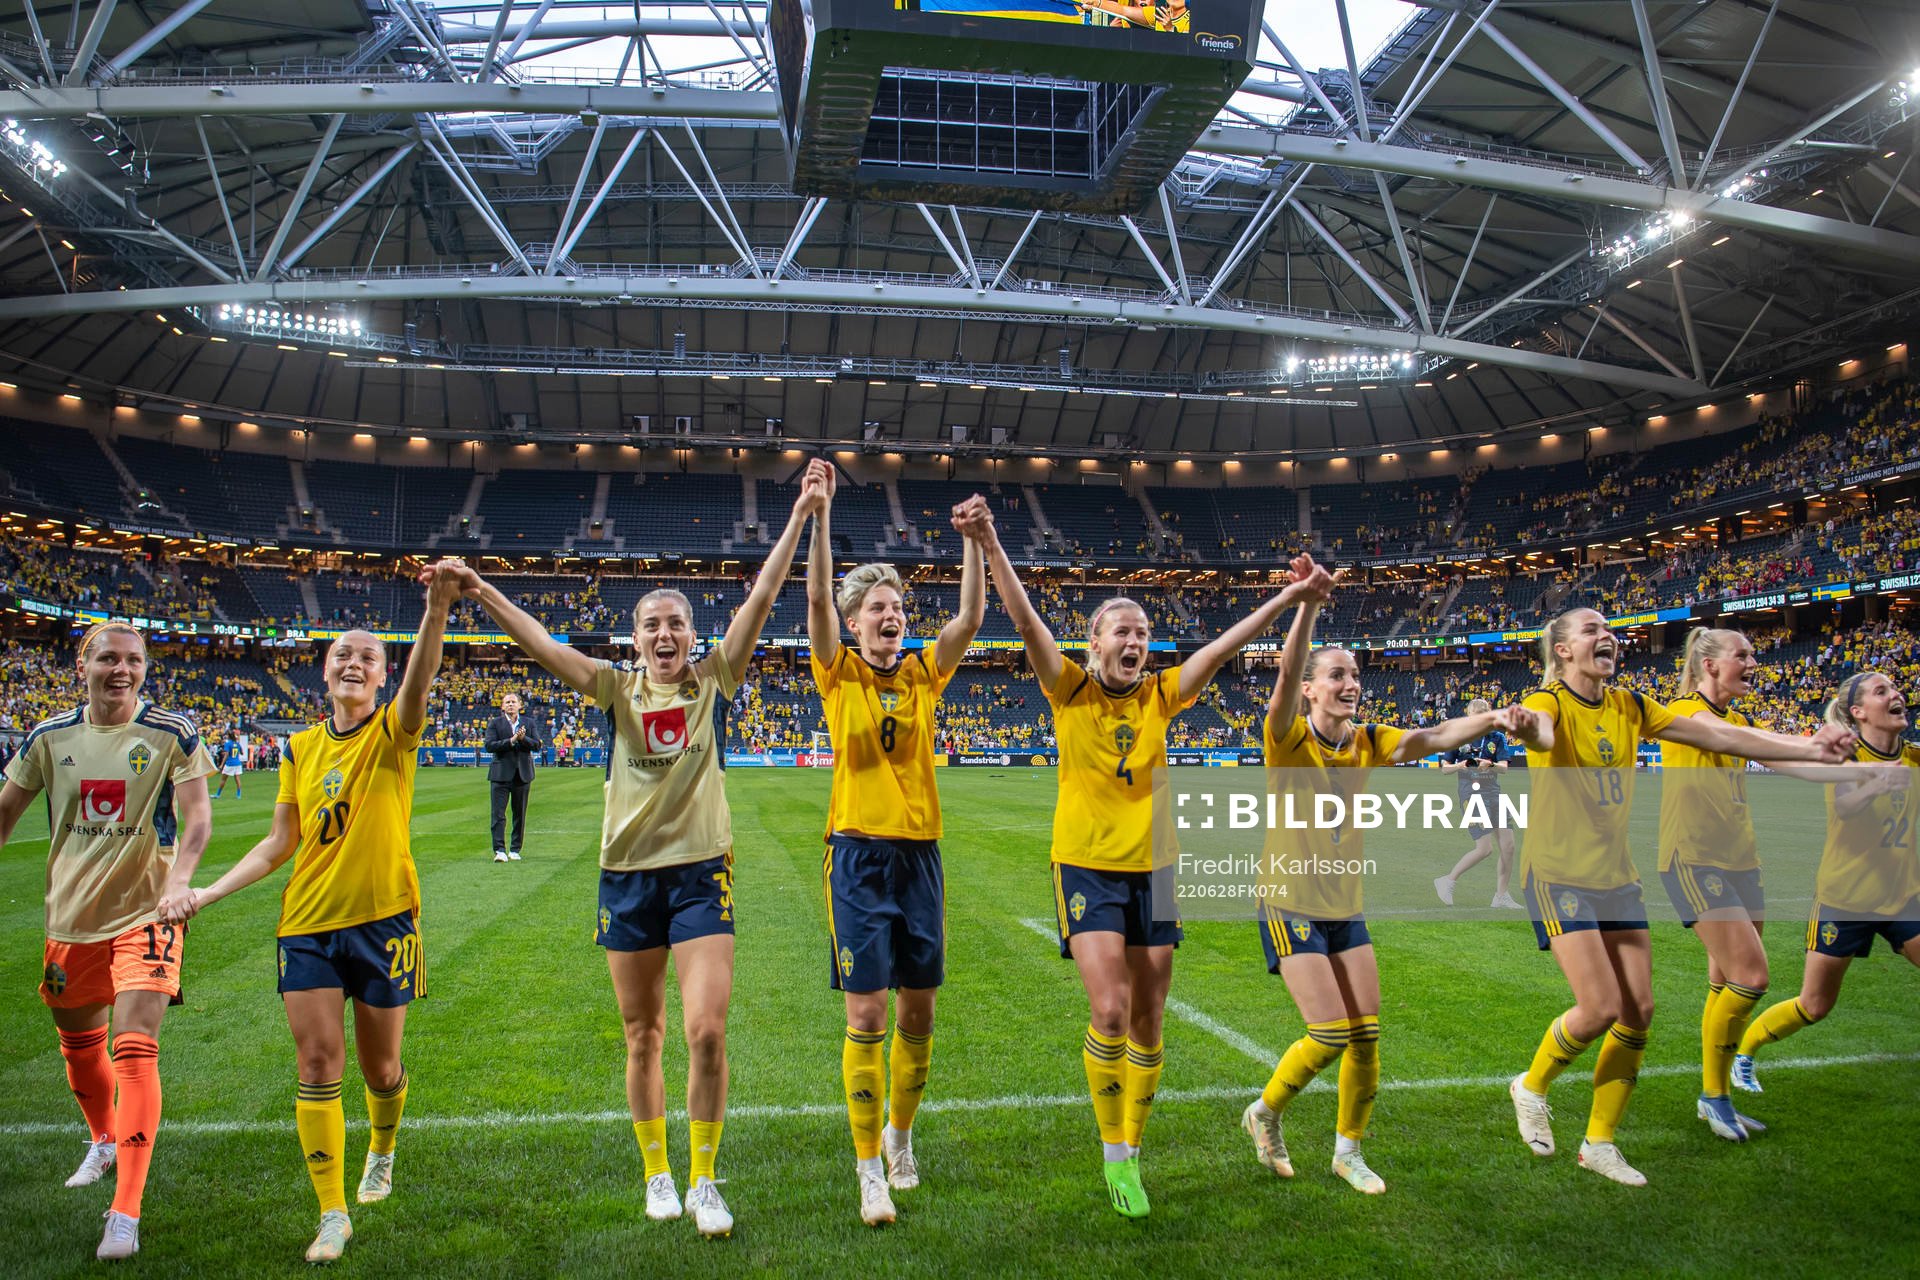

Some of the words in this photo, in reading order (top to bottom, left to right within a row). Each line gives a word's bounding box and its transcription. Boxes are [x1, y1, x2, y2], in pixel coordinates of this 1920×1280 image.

[1201, 37, 1234, 49] friends
[1843, 470, 1882, 485] TILLSAMMANS
[1883, 467, 1895, 477] MOT
[1880, 576, 1910, 590] SWISHA
[1723, 599, 1746, 612] SWISHA
[1746, 598, 1756, 609] 123
[1756, 597, 1768, 607] 204
[1769, 596, 1777, 606] 34
[150, 620, 166, 630] SWE
[190, 623, 197, 632] 3
[213, 624, 239, 635] 90:00
[254, 628, 260, 636] 1
[286, 629, 305, 638] BRA
[772, 638, 799, 646] SWISHA
[1247, 643, 1259, 651] 204
[1259, 643, 1268, 651] 34
[1365, 641, 1371, 649] 3
[1386, 639, 1409, 648] 90:00
[1453, 636, 1467, 645] BRA
[880, 716, 898, 753] 8
[231, 747, 239, 759] 17
[684, 743, 704, 757] PEL
[959, 756, 1000, 765] Sundström
[1116, 756, 1134, 786] 4
[1594, 769, 1625, 807] 18
[65, 823, 113, 837] SVENSKA
[117, 826, 145, 837] SPEL
[317, 800, 351, 846] 20
[1879, 816, 1910, 849] 22
[142, 923, 176, 964] 12
[385, 932, 418, 980] 20
